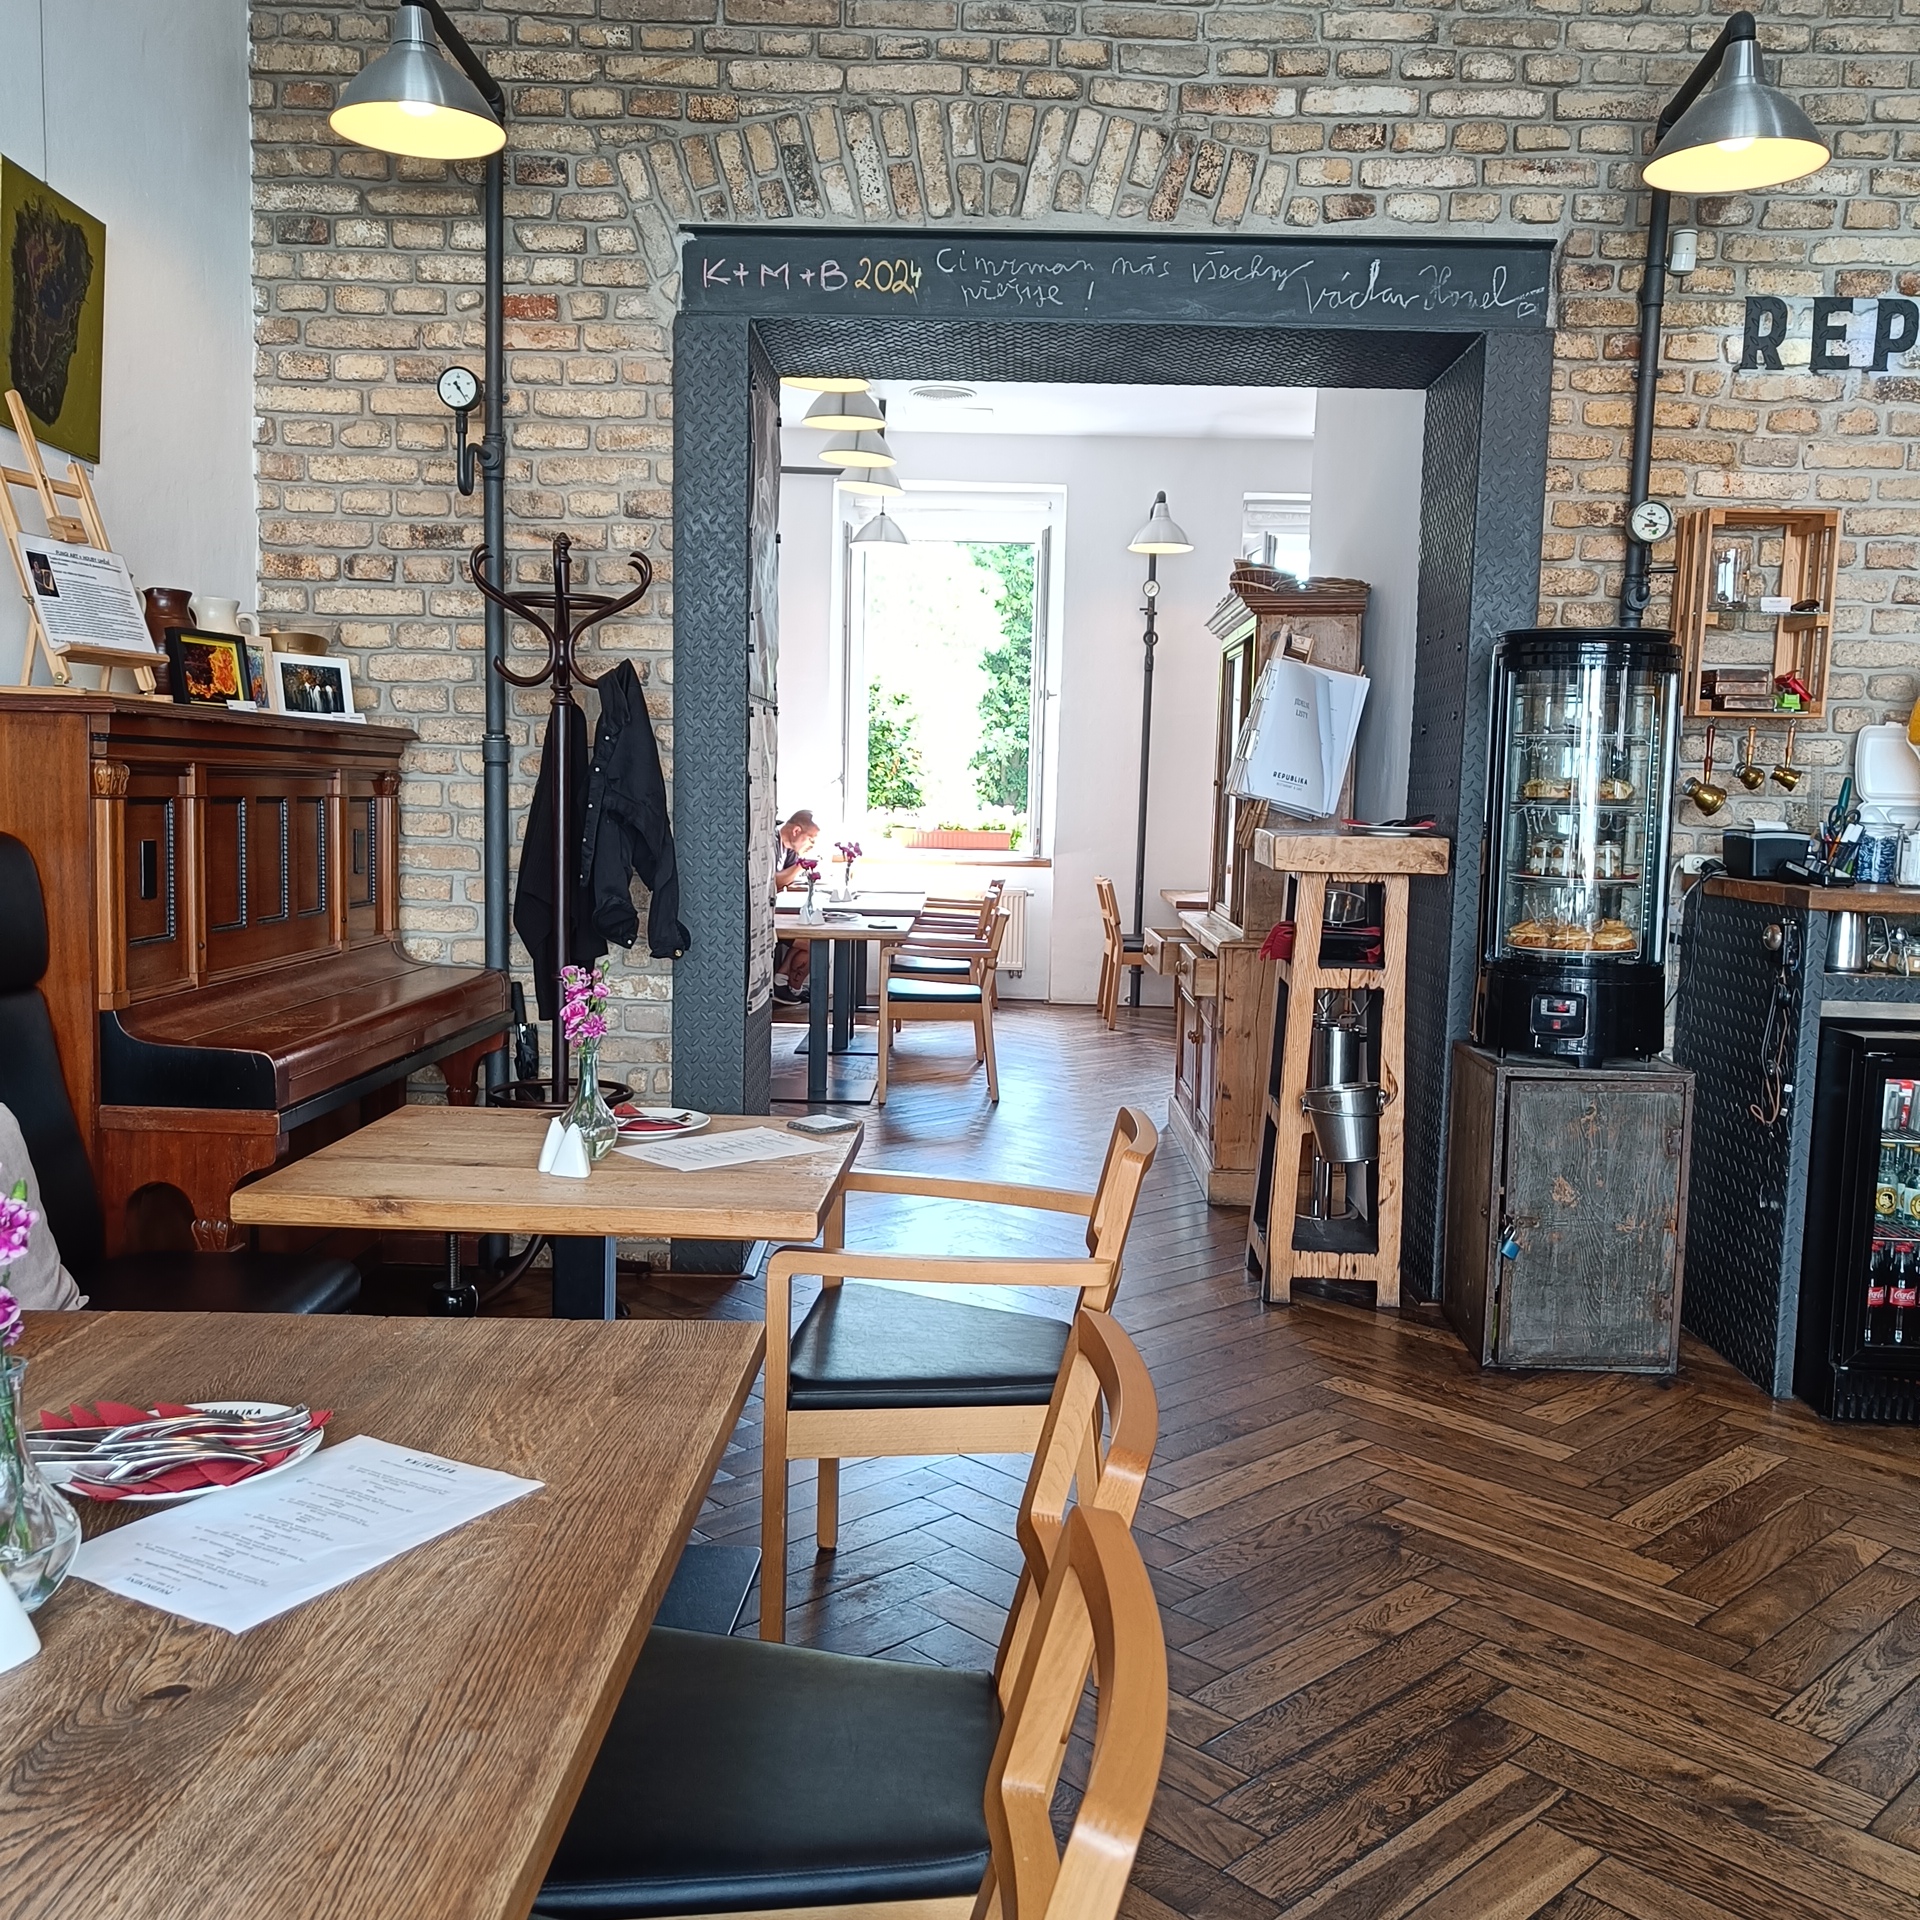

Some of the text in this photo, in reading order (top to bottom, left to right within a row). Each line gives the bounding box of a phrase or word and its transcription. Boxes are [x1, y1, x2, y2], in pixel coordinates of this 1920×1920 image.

[854, 256, 923, 295] 2024
[1740, 296, 1919, 371] REP
[1272, 770, 1308, 786] REPUBLIKA
